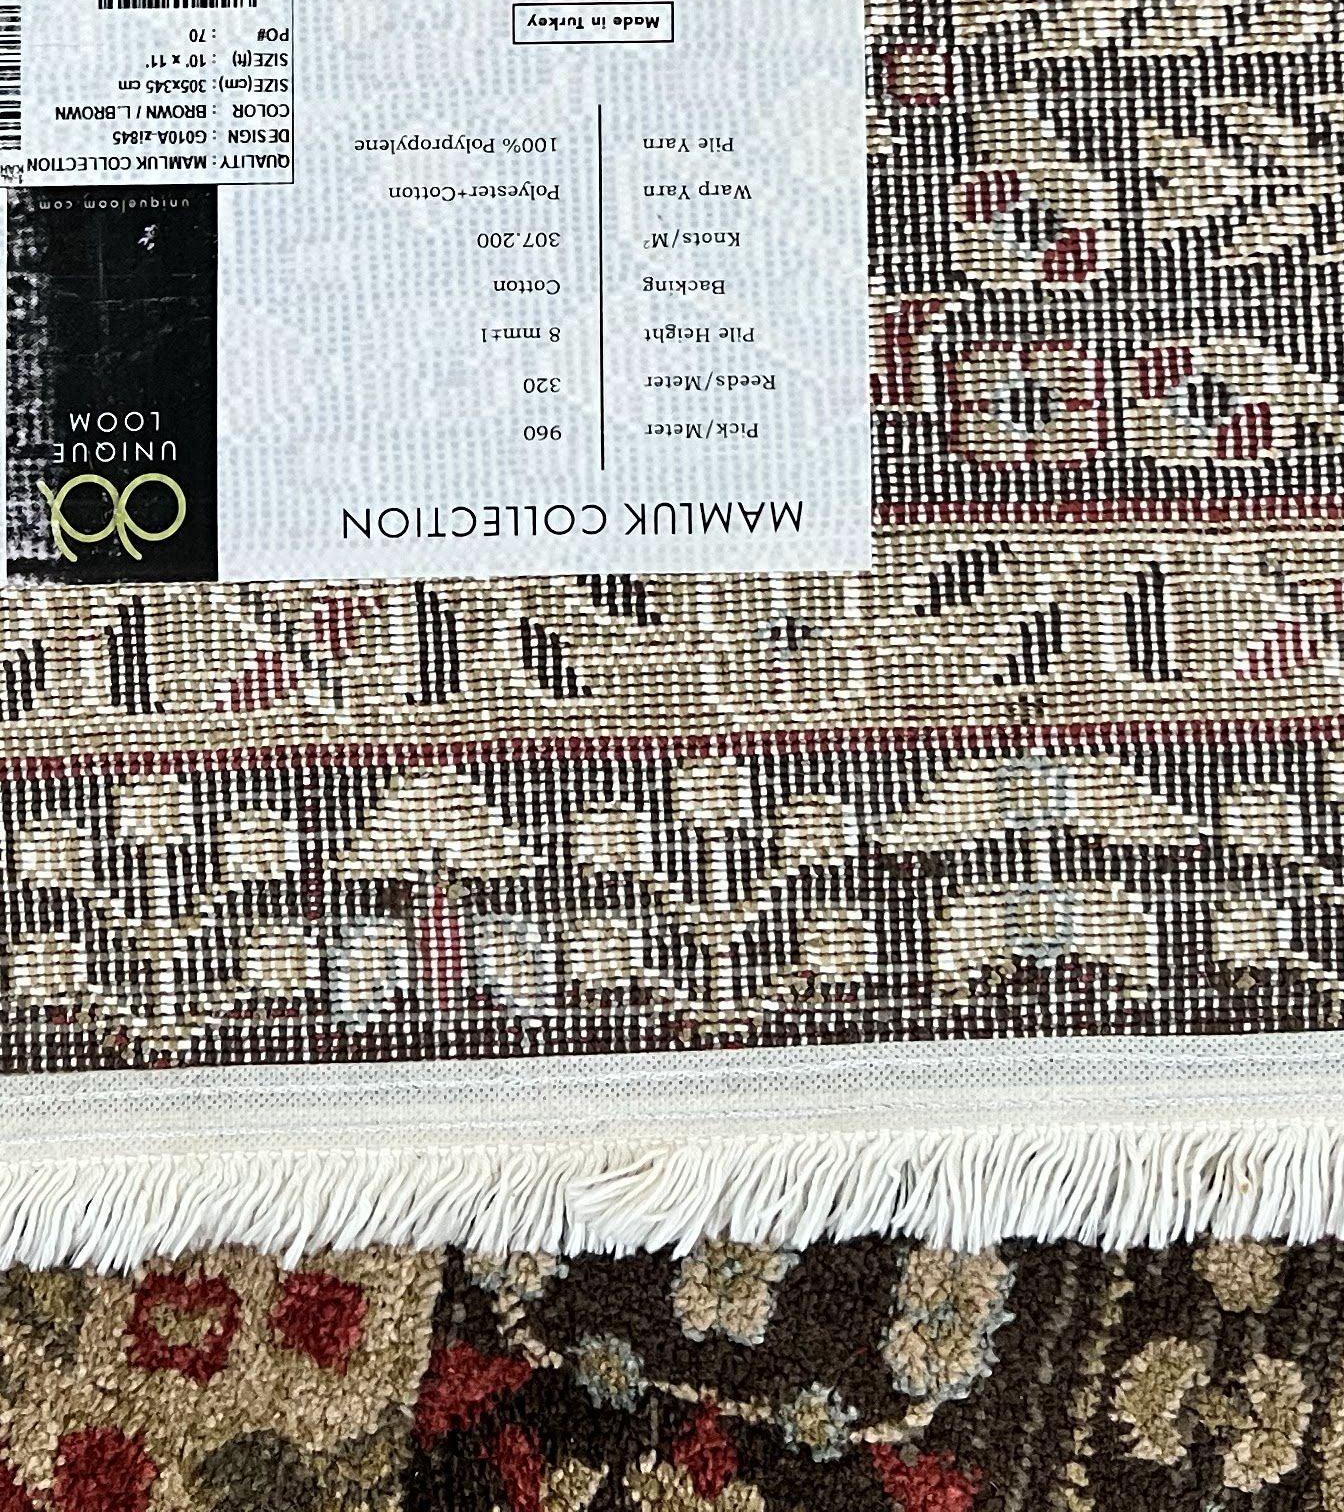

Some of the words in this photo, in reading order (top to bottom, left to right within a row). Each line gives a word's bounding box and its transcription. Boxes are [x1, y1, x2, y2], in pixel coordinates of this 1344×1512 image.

[526, 12, 583, 28] Turkey
[590, 16, 605, 29] in
[612, 15, 659, 28] Made
[188, 28, 206, 42] 70
[256, 26, 289, 42] PO#
[170, 54, 180, 64] x
[231, 50, 288, 66] SIZE(ft)
[118, 79, 140, 90] cm
[145, 78, 206, 92] 305x345
[54, 104, 130, 120] L.BROWN
[145, 104, 206, 118] BROWN
[231, 102, 289, 117] COLOR
[112, 129, 206, 144] G010A-zi845
[227, 128, 289, 143] DESIGN
[353, 133, 494, 154] Polypropylene
[501, 136, 557, 153] 100%
[642, 136, 690, 152] Yarn
[698, 136, 734, 152] Pile
[26, 156, 130, 171] COLLECTION
[135, 154, 206, 170] MAMLUK
[387, 179, 560, 201] Polyester+Cotton
[642, 184, 690, 199] Yarn
[698, 180, 751, 198] Warp
[476, 230, 560, 248] 307.200
[492, 278, 560, 294] Cotton
[642, 276, 726, 296] Backing
[480, 326, 540, 342] mm±1
[548, 326, 560, 342] 8
[643, 322, 710, 343] Height
[718, 325, 754, 342] Pile
[522, 376, 560, 394] 320
[644, 371, 775, 390] Reeds/Meter
[69, 411, 158, 431] LOOM
[644, 418, 758, 438] Pick/Meter
[522, 423, 562, 442] 960
[51, 440, 176, 462] UNIQUE
[341, 504, 606, 538] COLLECTION
[623, 500, 802, 534] MAMLUK
